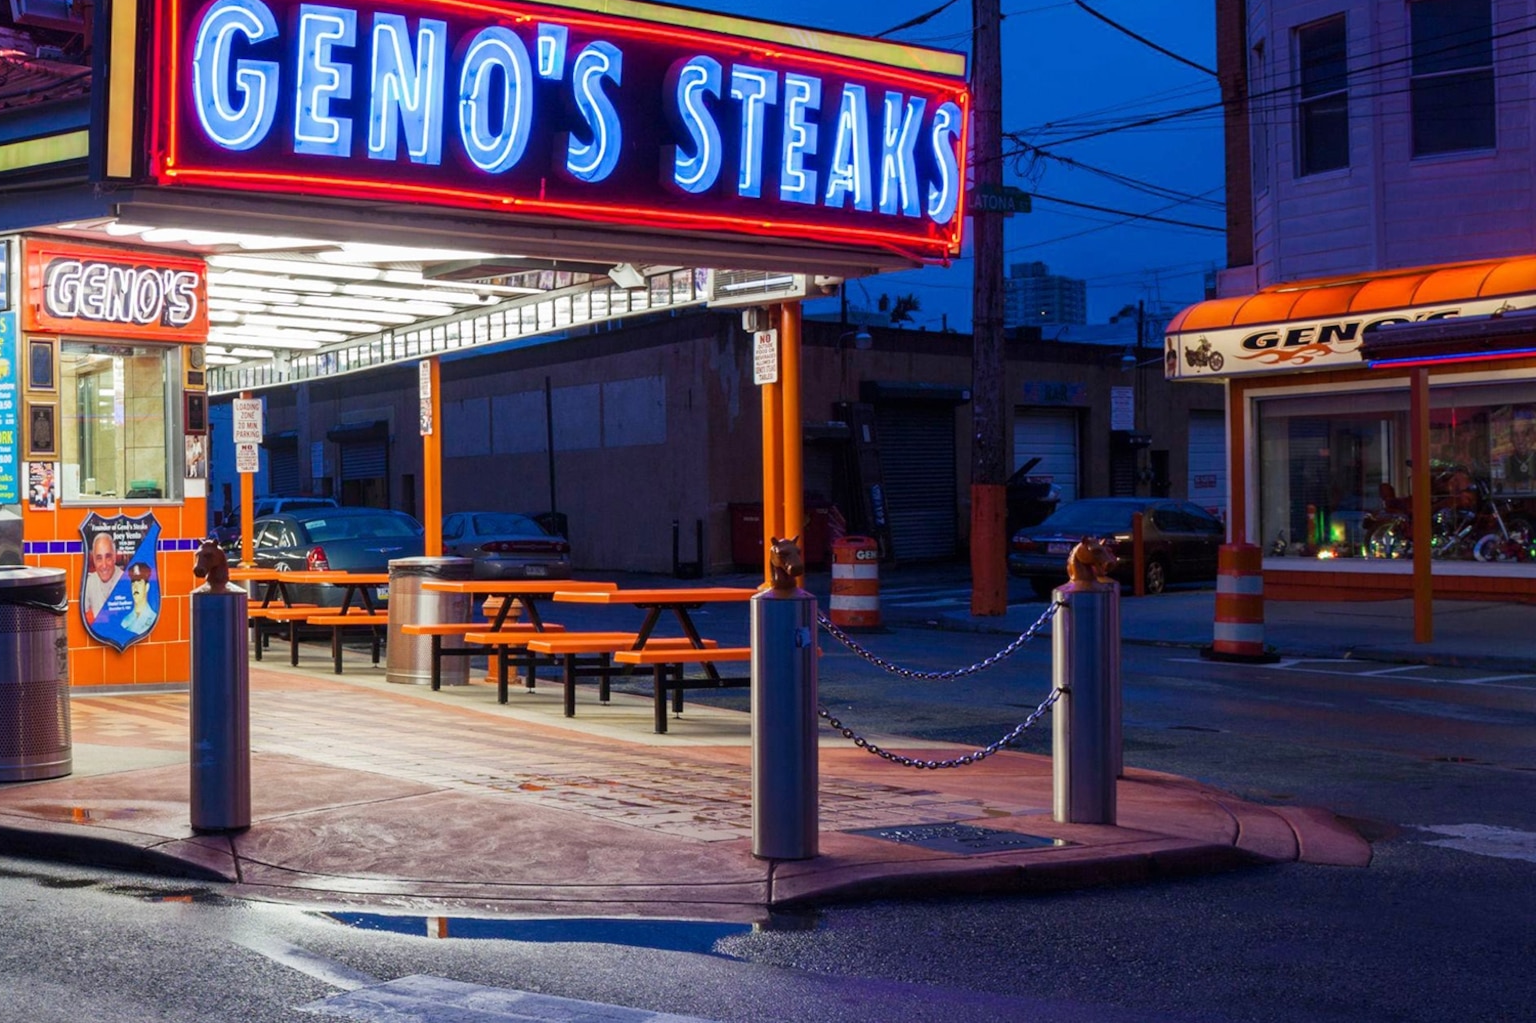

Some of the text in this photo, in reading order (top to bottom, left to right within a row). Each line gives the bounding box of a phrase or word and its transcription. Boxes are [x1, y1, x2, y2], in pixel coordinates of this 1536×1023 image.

[674, 53, 962, 226] STEAKS
[968, 194, 1015, 210] LATONA
[45, 257, 200, 327] GENO'S
[760, 334, 771, 344] NO
